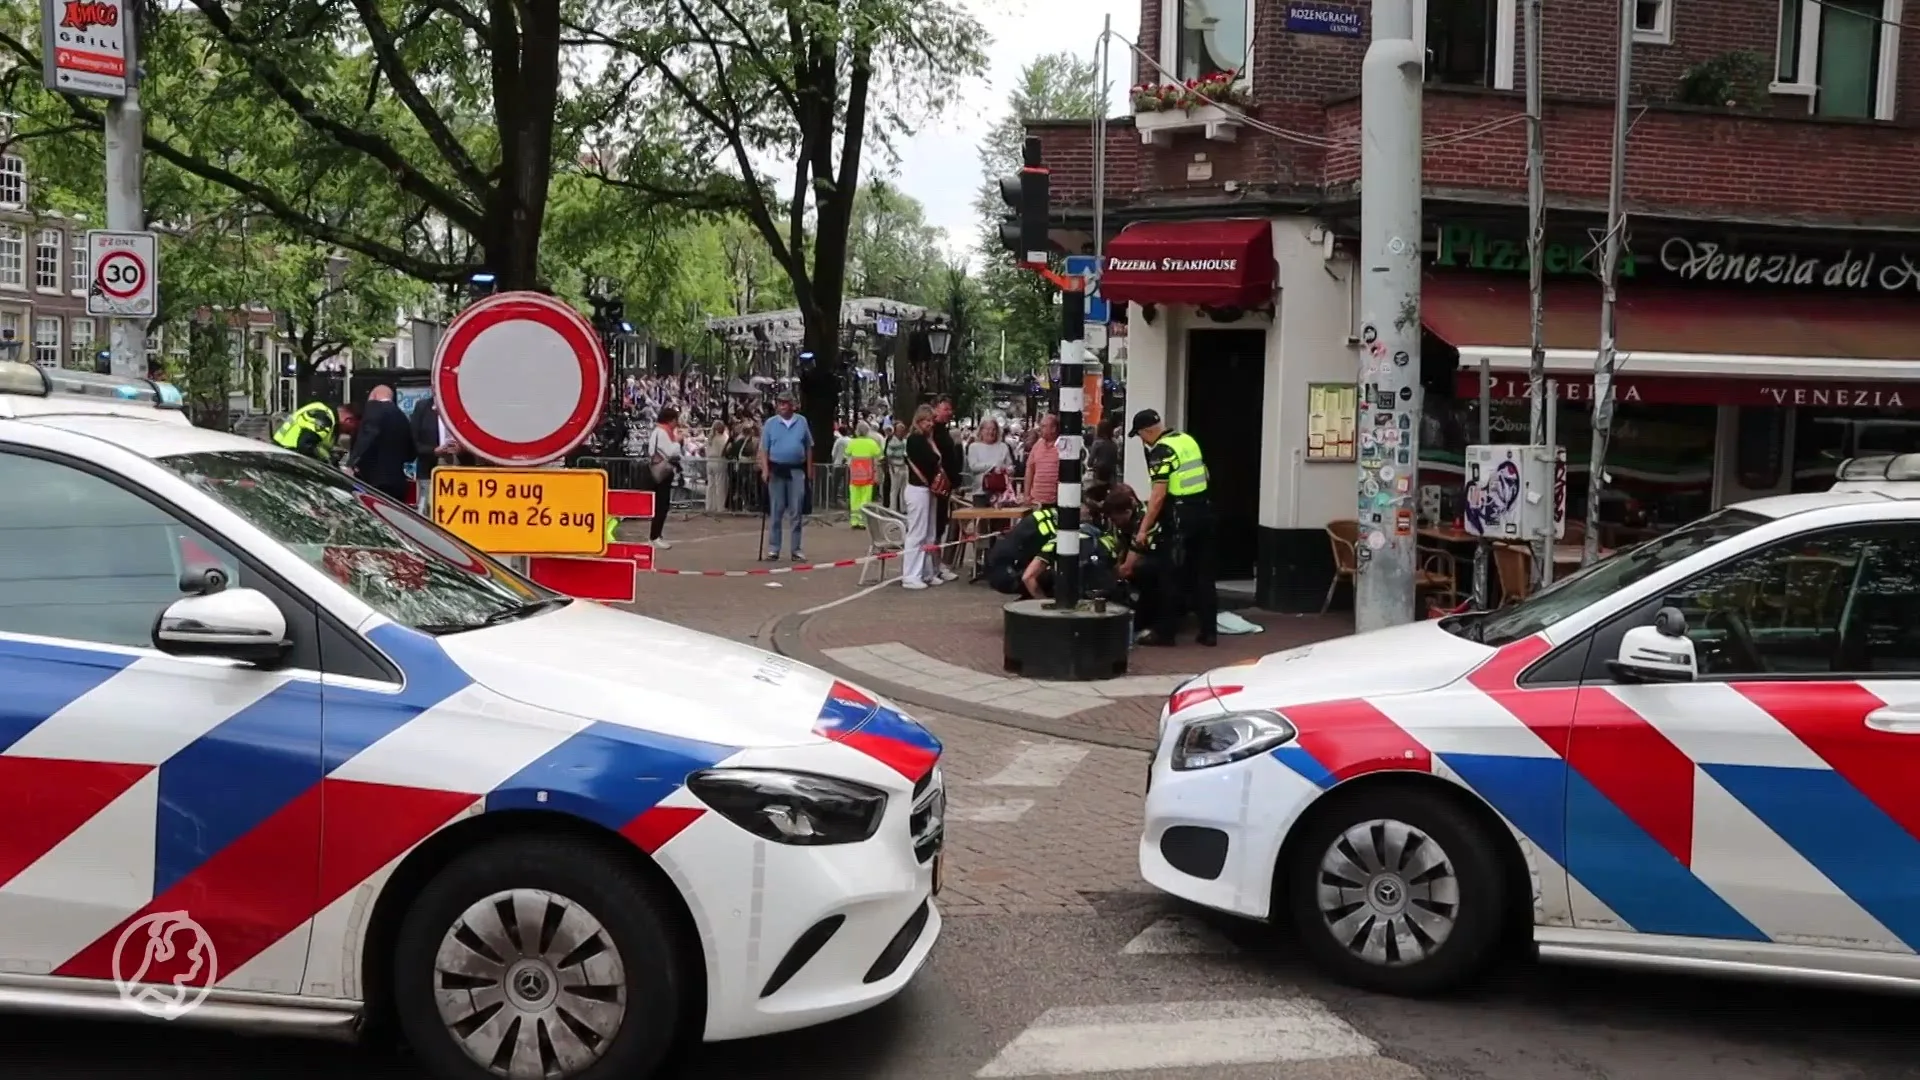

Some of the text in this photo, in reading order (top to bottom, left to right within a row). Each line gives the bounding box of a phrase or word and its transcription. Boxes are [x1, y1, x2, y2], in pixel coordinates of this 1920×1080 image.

[1290, 8, 1358, 24] ROZENGRACHT
[60, 32, 120, 50] GRILL
[1108, 257, 1238, 271] PIZZERIA STEAKHOUSE
[1661, 237, 1820, 284] Venezia
[1823, 250, 1876, 288] del
[106, 264, 138, 284] 30
[438, 477, 543, 505] Ma 19 aug
[437, 504, 595, 533] t/m ma 26 aug
